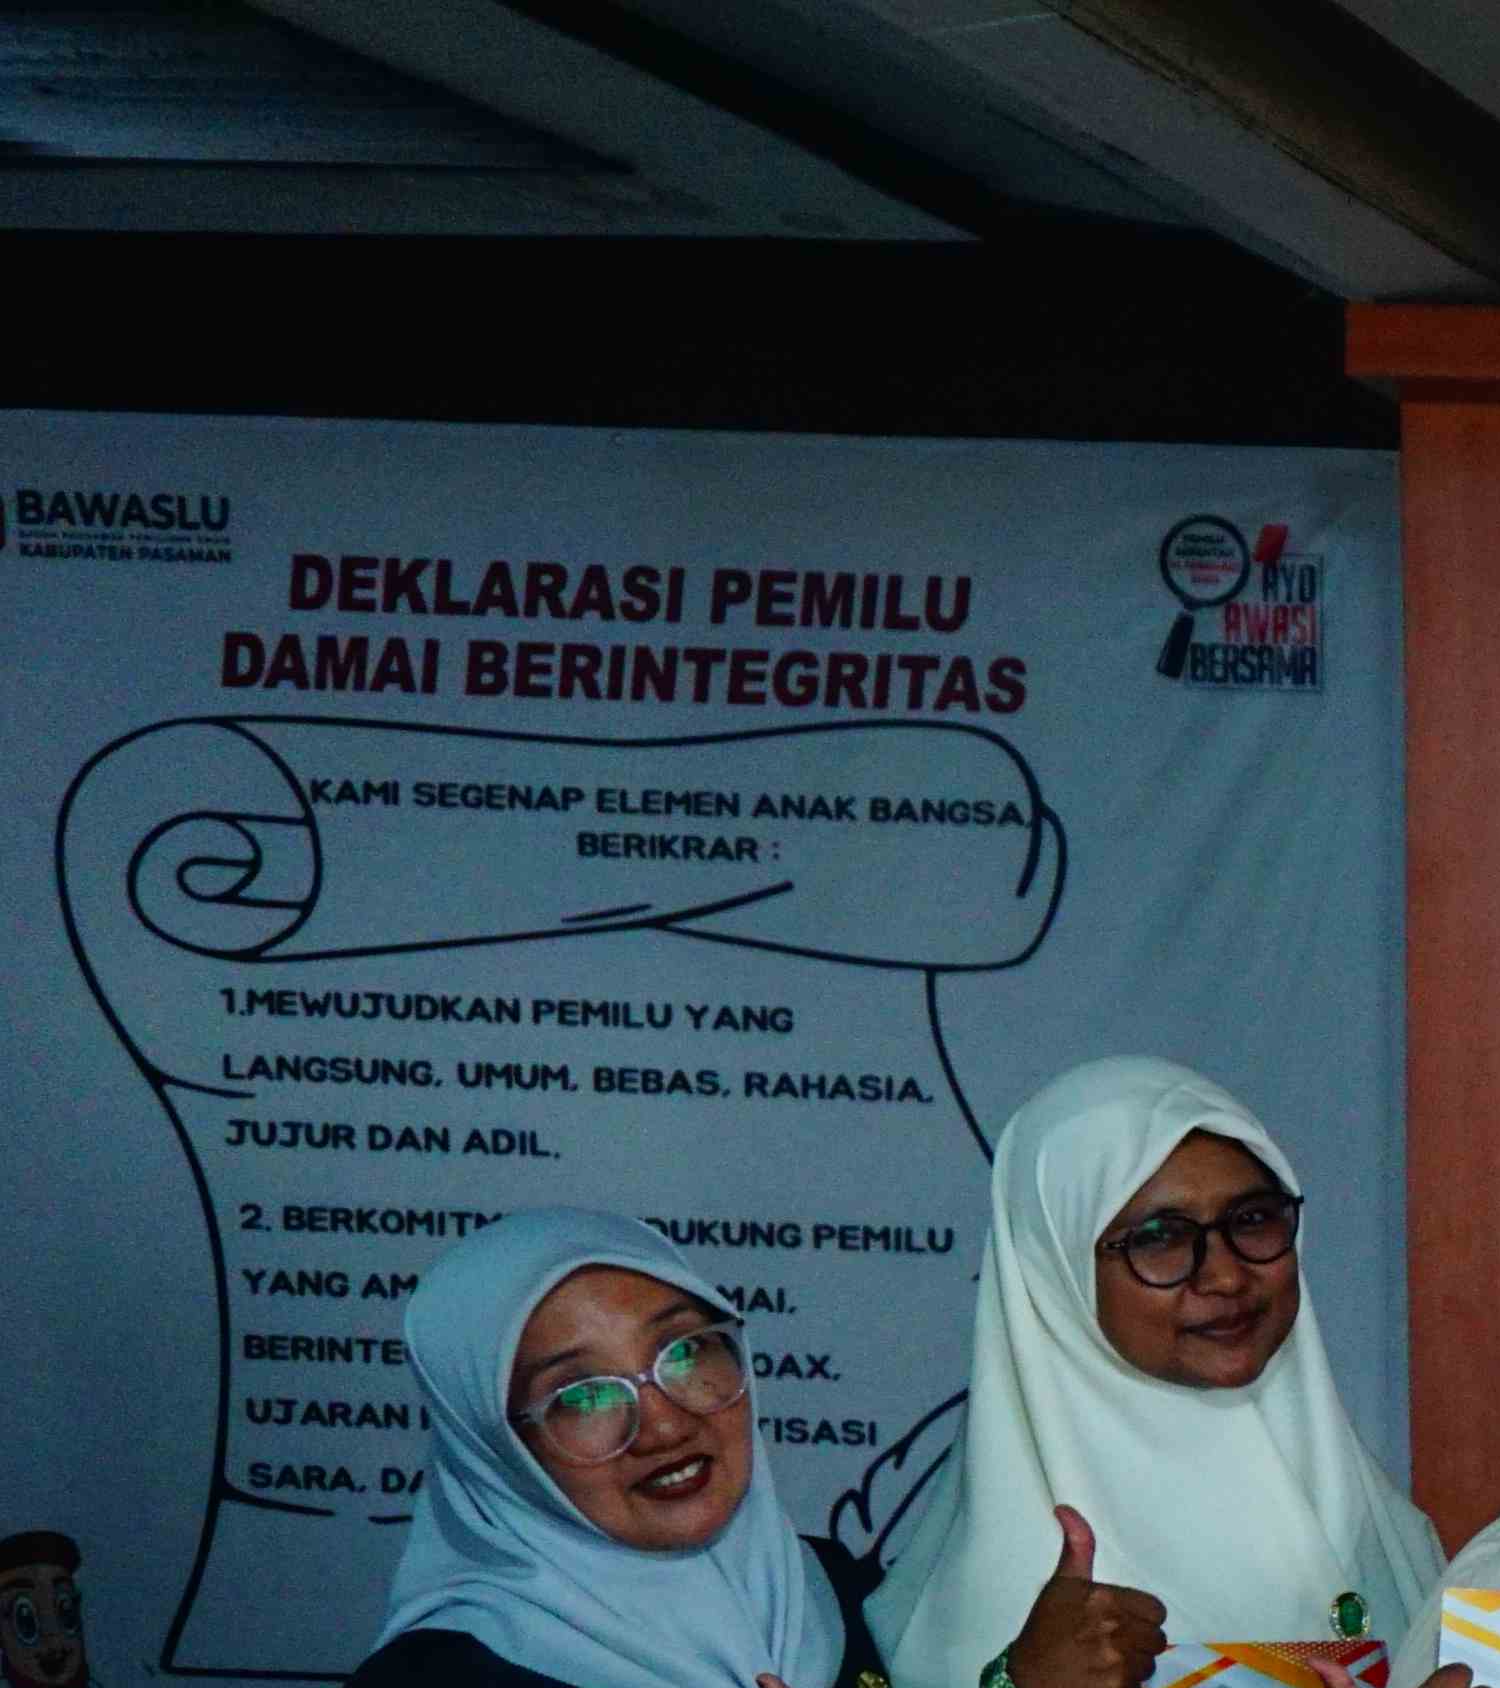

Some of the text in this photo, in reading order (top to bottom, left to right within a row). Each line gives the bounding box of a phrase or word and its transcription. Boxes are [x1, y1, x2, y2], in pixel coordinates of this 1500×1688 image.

[17, 489, 230, 531] BAWASLU
[289, 553, 972, 634] DEKLARASI PEMILU
[1262, 563, 1316, 604] AYO
[1225, 603, 1316, 645] AWASI
[221, 631, 1028, 714] DAMAI BERINTEGRITAS
[1190, 643, 1317, 686] BERSAMA
[309, 779, 399, 806] KAMI
[412, 781, 585, 812] SEGENAP
[597, 787, 739, 818] ELEMEN
[752, 794, 856, 822] ANAK
[577, 831, 759, 862] BERIKRAR
[532, 999, 673, 1029] PEMILU
[685, 1004, 794, 1034] YANG
[225, 1118, 561, 1159] JUJUR DAN ADIL.
[239, 1203, 271, 1232] 2.
[812, 1223, 954, 1253] PEMILU
[242, 1268, 350, 1298] YANG
[361, 1273, 419, 1300] AM
[243, 1334, 841, 1381] BERINTE OAX,
[246, 1397, 409, 1429] UJARAN
